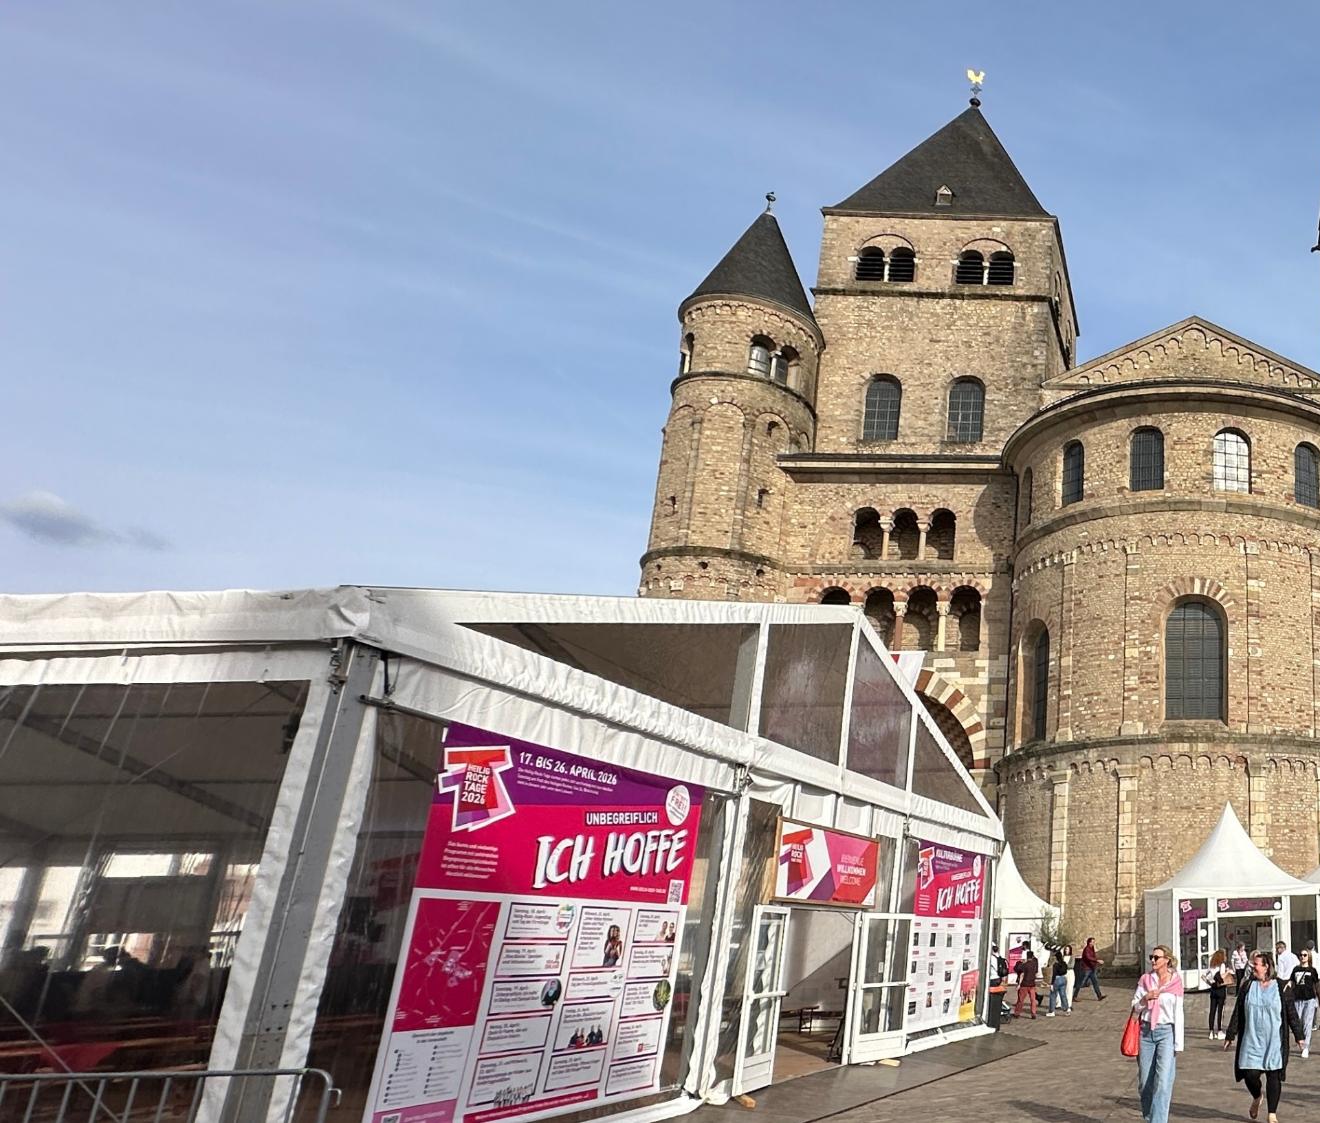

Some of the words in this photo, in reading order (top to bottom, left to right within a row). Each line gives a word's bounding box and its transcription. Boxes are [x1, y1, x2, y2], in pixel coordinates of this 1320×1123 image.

[467, 764, 491, 775] HEILIG
[519, 752, 534, 766] 17.
[535, 756, 554, 769] BIS
[553, 761, 568, 774] 26.
[569, 765, 597, 780] APRIL
[597, 771, 618, 785] 2026
[465, 772, 489, 784] ROCK
[463, 781, 487, 794] TAGE
[461, 792, 486, 805] 2026
[586, 812, 658, 825] UNBEGREIFLICH
[532, 834, 595, 890] ICH
[603, 829, 688, 877] HOFFE
[936, 886, 954, 914] ICH
[954, 879, 981, 907] HOFFE
